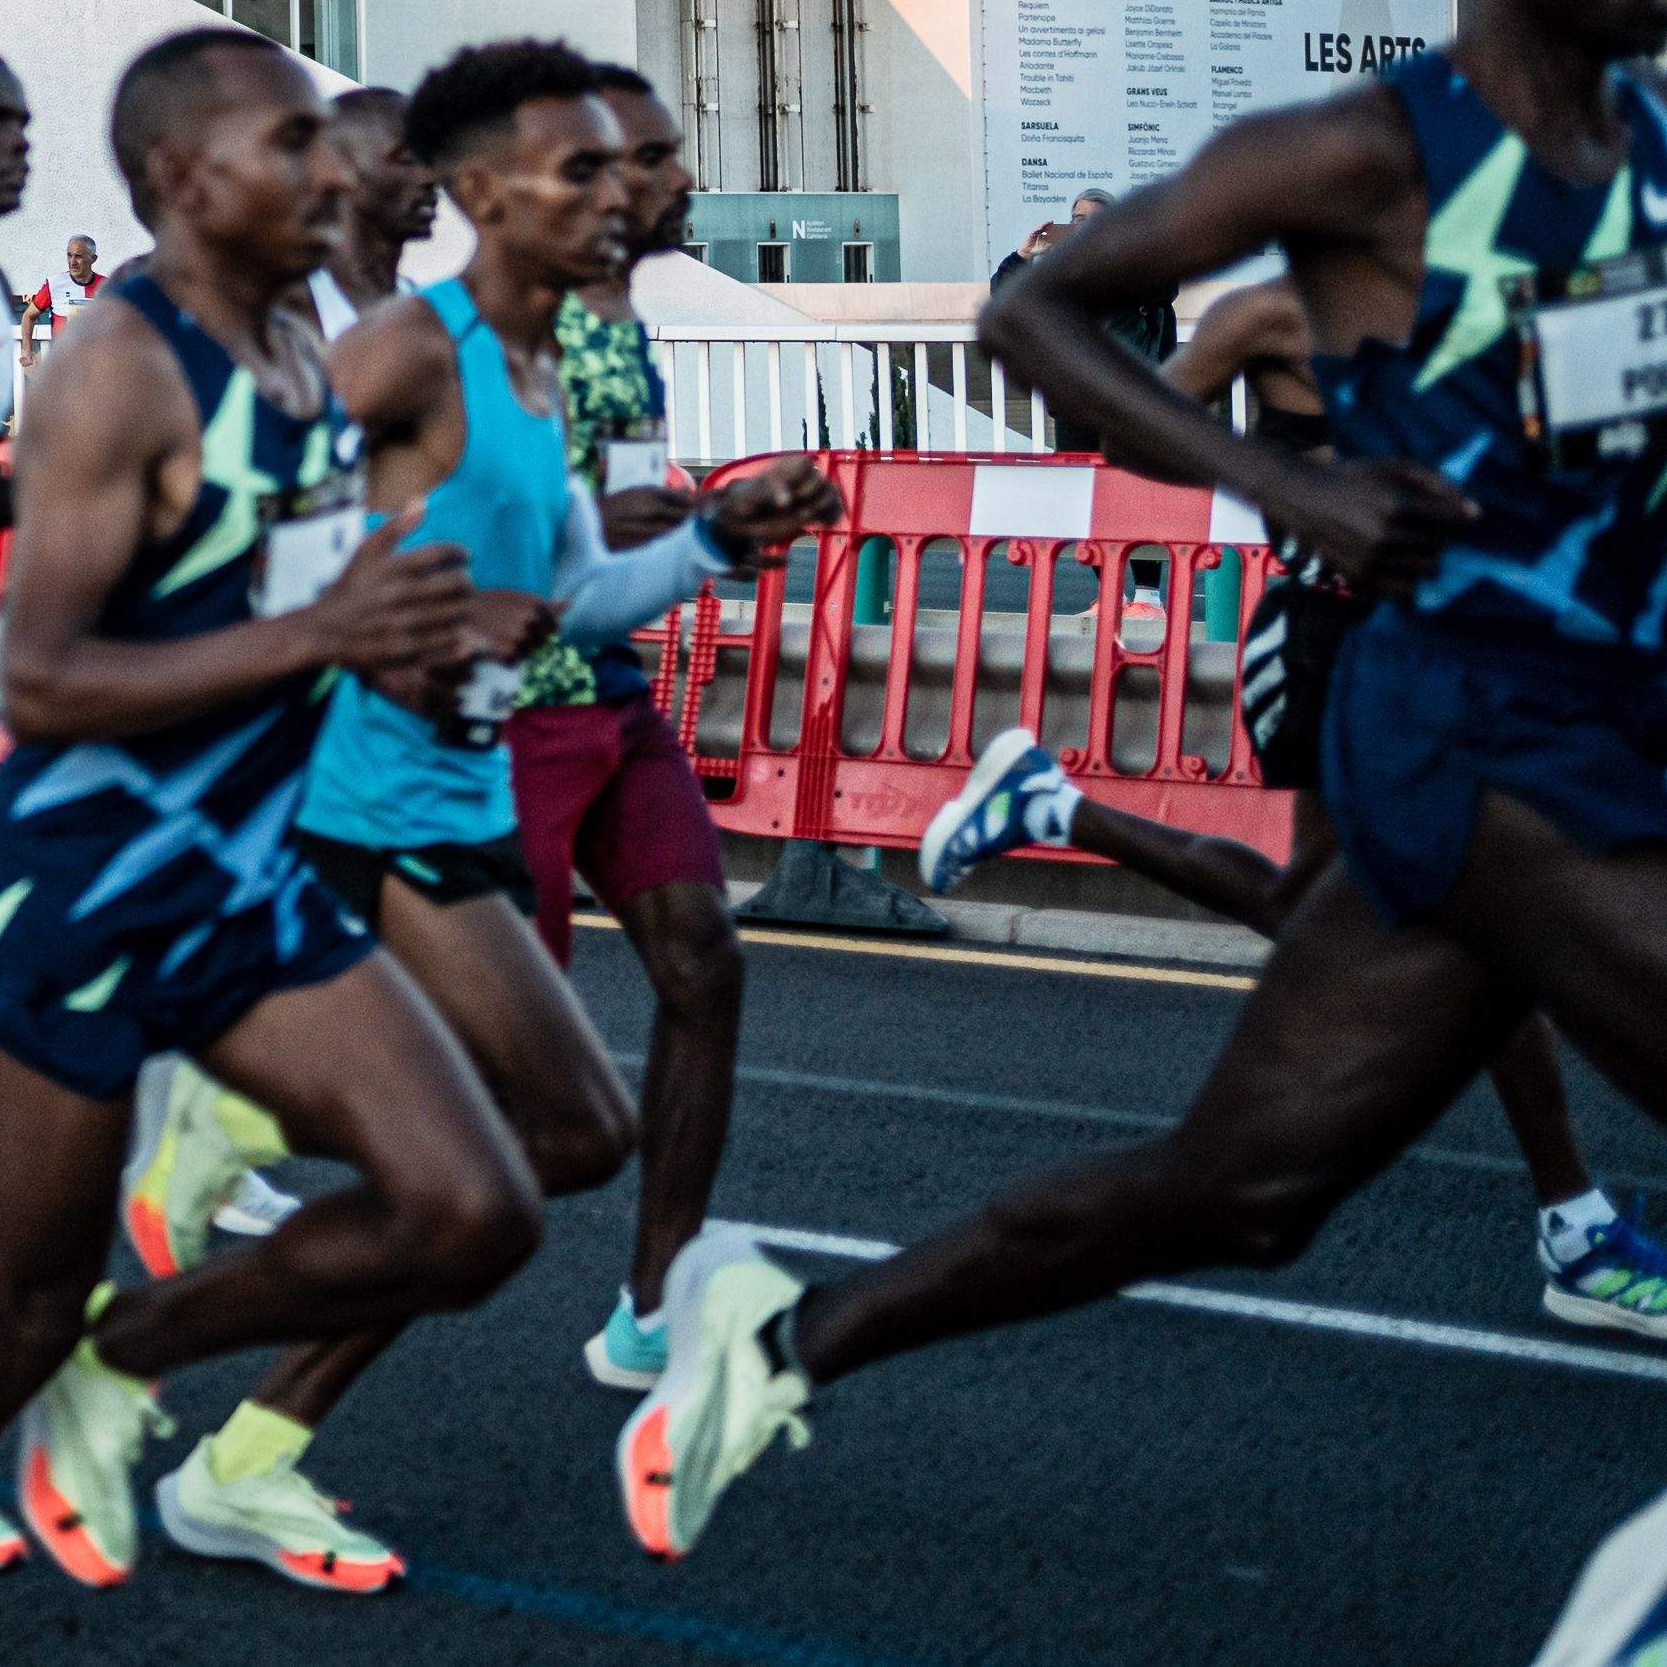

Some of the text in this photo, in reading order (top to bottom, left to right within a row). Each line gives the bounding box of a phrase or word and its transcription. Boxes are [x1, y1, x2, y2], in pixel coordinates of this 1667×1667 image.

[1018, 0, 1049, 10] Requiem
[1018, 13, 1056, 23] Partenope
[1018, 25, 1029, 34] Un
[1018, 37, 1082, 47] Madama Butterfly
[1019, 49, 1031, 57] Les
[1032, 50, 1056, 58] contes
[1304, 32, 1353, 74] LES
[1019, 61, 1055, 70] Ariodante
[1211, 65, 1243, 74] FLAMENCO
[1020, 73, 1046, 82] Trouble
[1047, 74, 1054, 82] in
[1020, 85, 1052, 94] Macbeth
[1126, 87, 1168, 96] GRANS VEUS
[1127, 100, 1138, 108] Leo
[1021, 121, 1059, 130] SARSUELA
[1021, 158, 1048, 166] DANSA
[1021, 170, 1043, 179] Ballet
[1044, 170, 1076, 179] Nacional
[1077, 170, 1086, 179] de
[1022, 195, 1031, 203] La
[792, 220, 806, 239] N
